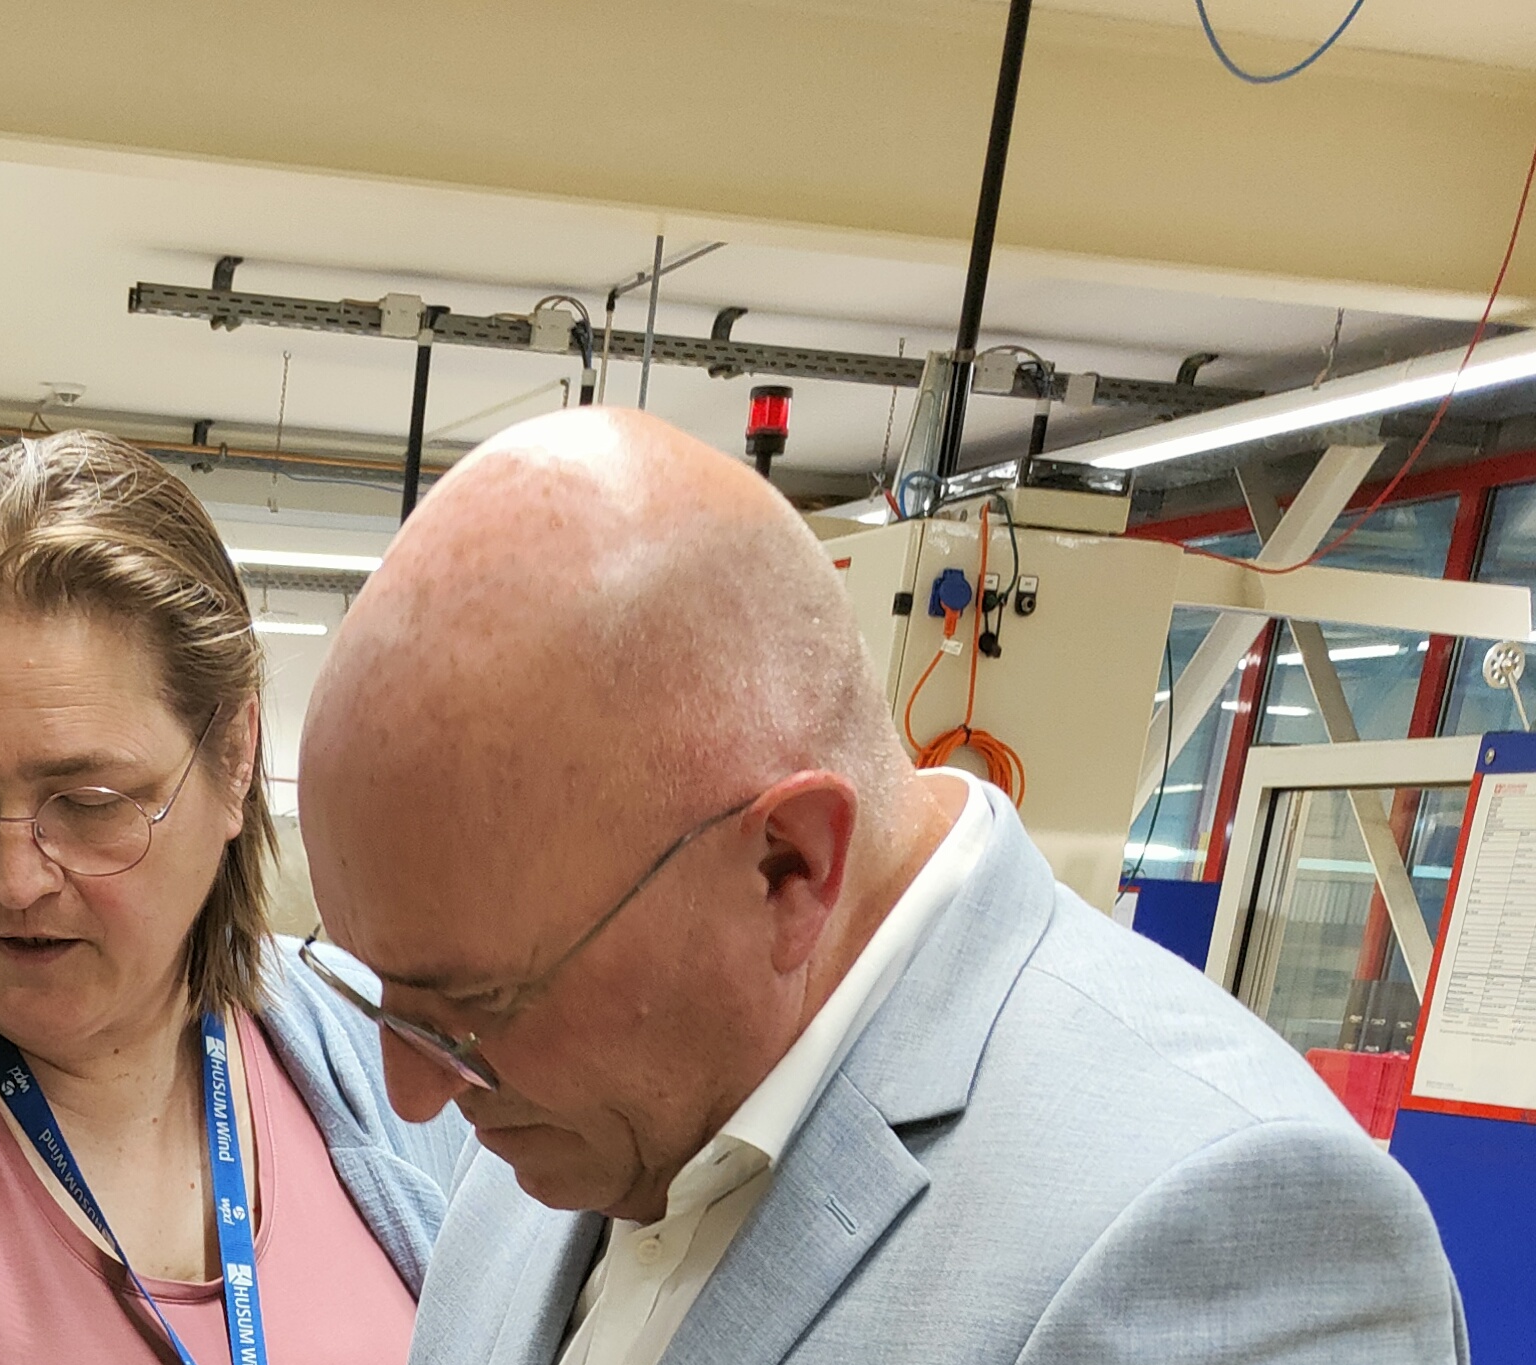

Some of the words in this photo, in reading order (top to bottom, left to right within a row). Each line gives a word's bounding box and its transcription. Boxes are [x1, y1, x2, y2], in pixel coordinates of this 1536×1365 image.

[7, 1065, 31, 1094] wpd
[211, 1060, 228, 1119] HUSUM
[38, 1128, 68, 1174] Wind
[219, 1121, 235, 1162] Wind
[219, 1197, 235, 1225] wpd
[234, 1285, 255, 1344] HUSUM
